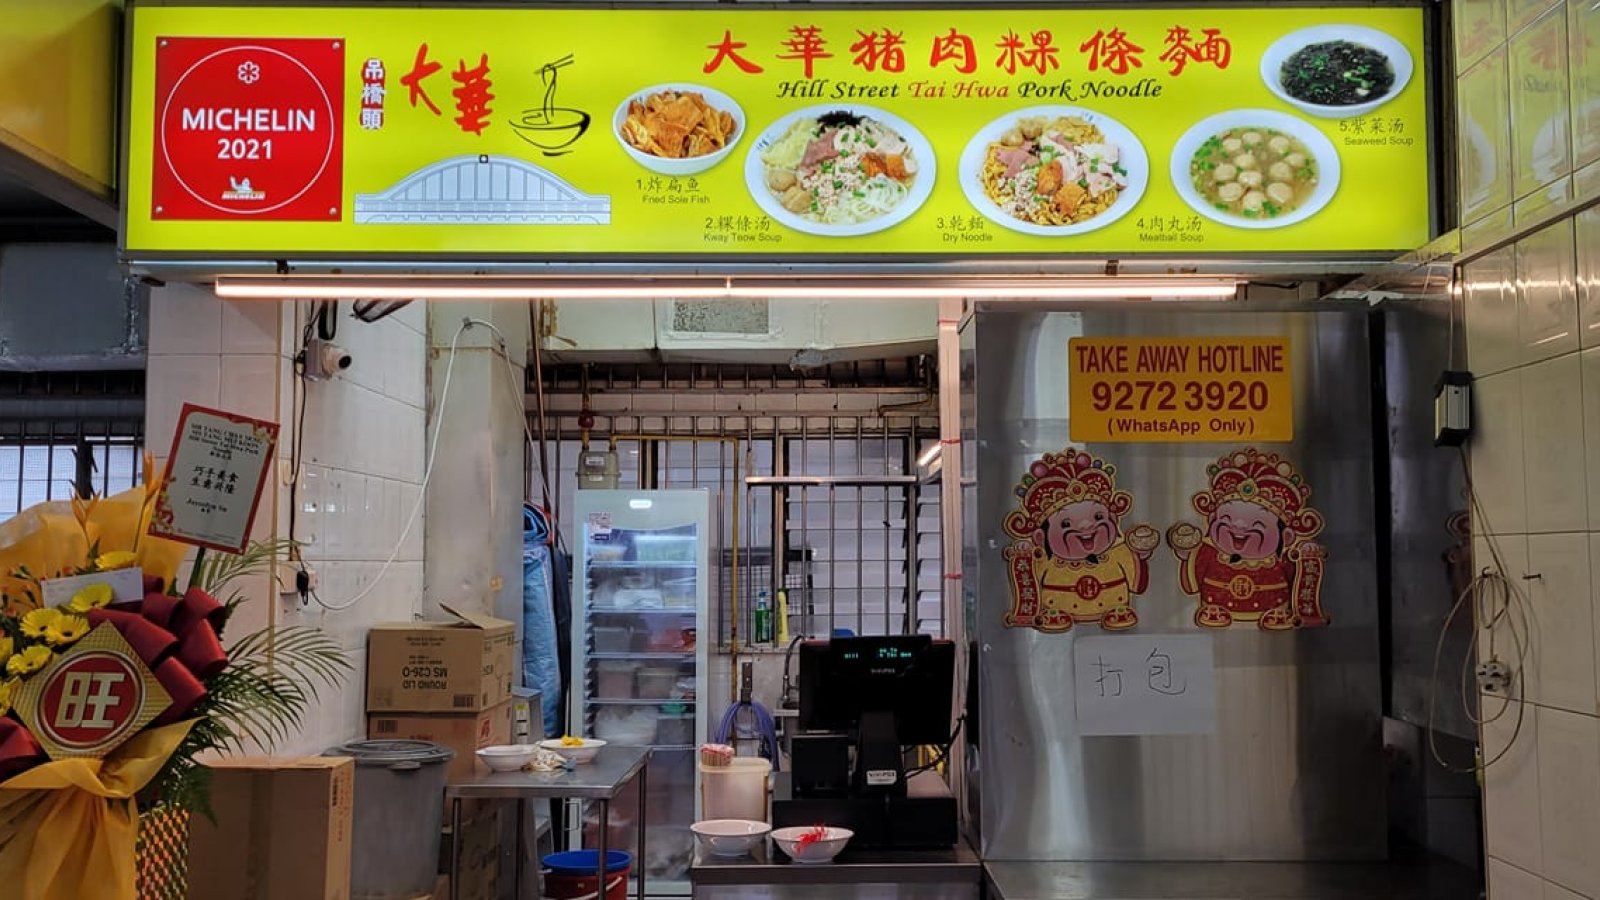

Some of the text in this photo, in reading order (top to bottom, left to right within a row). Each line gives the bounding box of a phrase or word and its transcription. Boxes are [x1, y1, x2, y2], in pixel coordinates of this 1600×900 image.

[361, 58, 386, 130] 吊橋頭
[776, 78, 1163, 101] Hill Street Tai Hwa Pork Noodle
[182, 108, 315, 132] MICHELIN
[217, 139, 272, 159] 2021
[1344, 137, 1413, 146] Seaweed Soup
[642, 195, 710, 204] Fried Sole Fish
[704, 233, 782, 243] Kway Teow Soup
[943, 232, 993, 243] Dry Noodle
[1140, 233, 1203, 242] Meatball Soup
[1075, 345, 1283, 373] TAKE AWAY HOTLINE
[1092, 381, 1268, 411] 9272 3920
[433, 667, 448, 677] MS
[1091, 648, 1186, 697] 打包
[403, 680, 448, 689] ROUND LID
[55, 671, 125, 729] 旺
